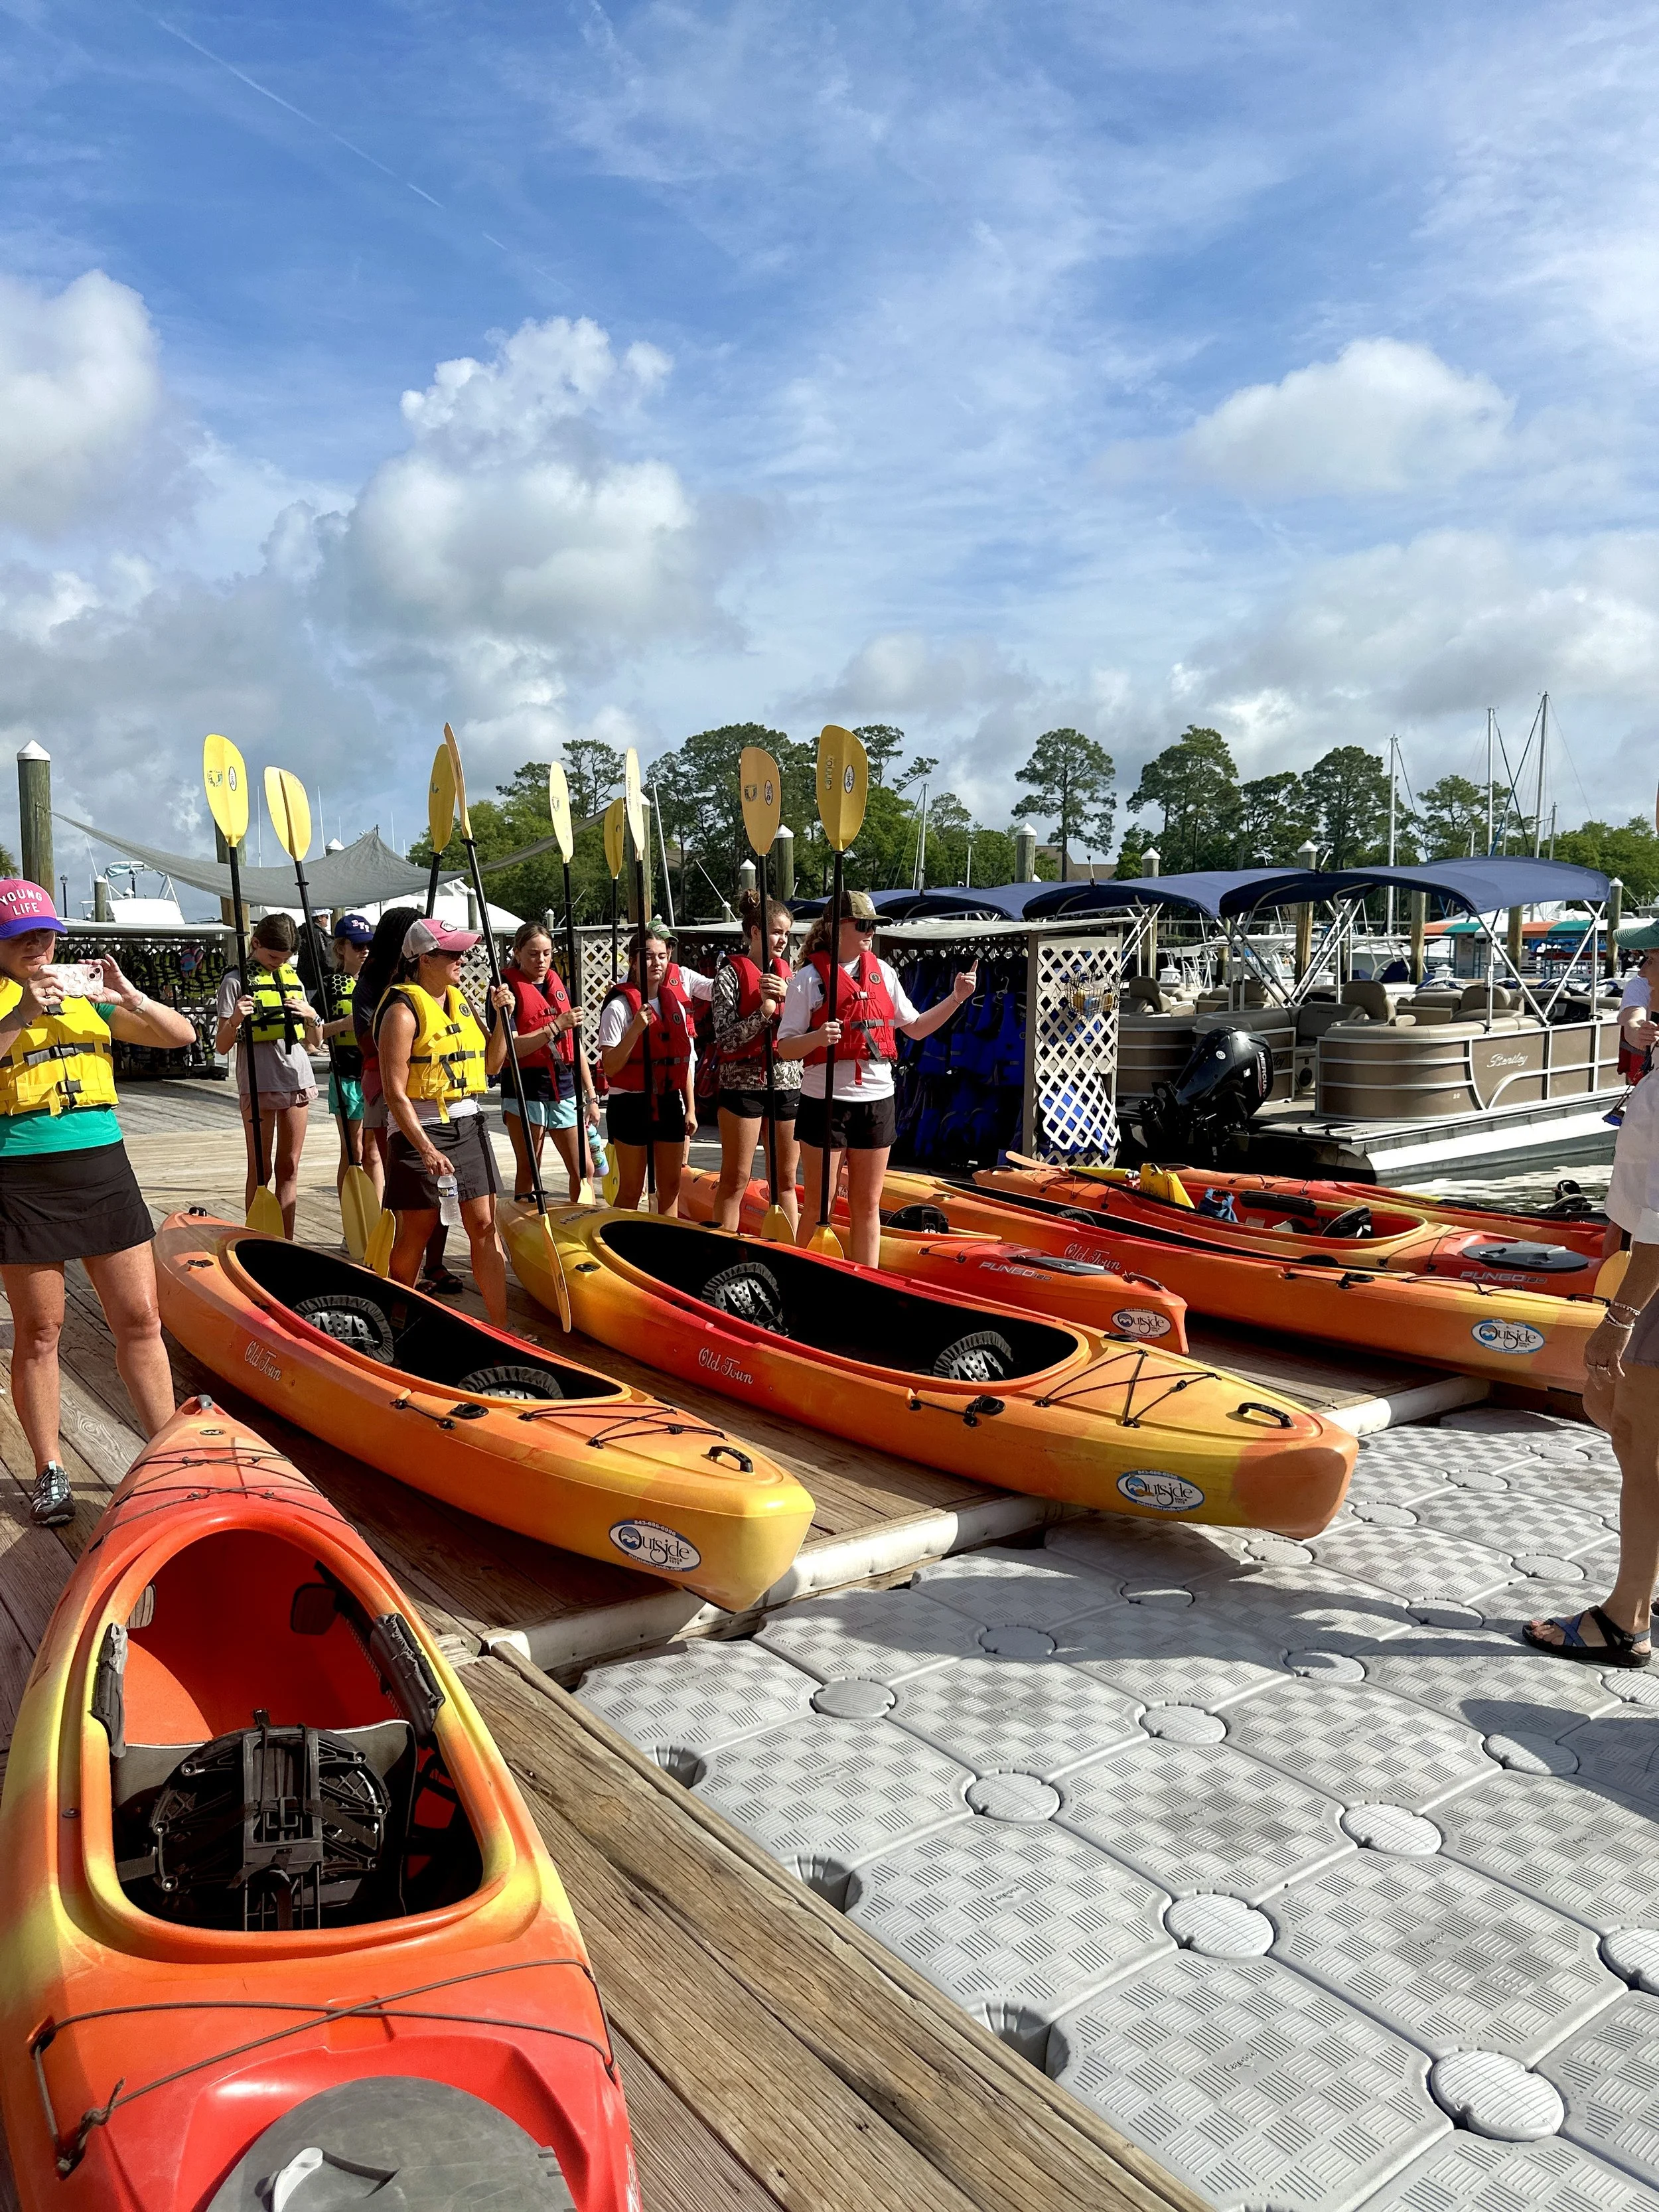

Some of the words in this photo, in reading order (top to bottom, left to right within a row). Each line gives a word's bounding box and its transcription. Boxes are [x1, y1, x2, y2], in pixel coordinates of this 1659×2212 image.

[0, 889, 43, 905] YOUNG
[12, 902, 40, 915] LIFE
[1486, 1052, 1528, 1068] Bentley
[1064, 1242, 1089, 1262] Old
[1086, 1249, 1121, 1270] Town
[979, 1262, 1036, 1278] PUNGO
[1460, 1270, 1526, 1282] PUNGO
[1117, 1313, 1165, 1335] Outside
[1479, 1324, 1537, 1349] Outside
[245, 1340, 264, 1367] Old
[259, 1350, 282, 1381] Town
[699, 1347, 721, 1372] Old
[721, 1357, 755, 1385] Town
[1125, 1477, 1193, 1506] Outside
[618, 1526, 689, 1564] Outside
